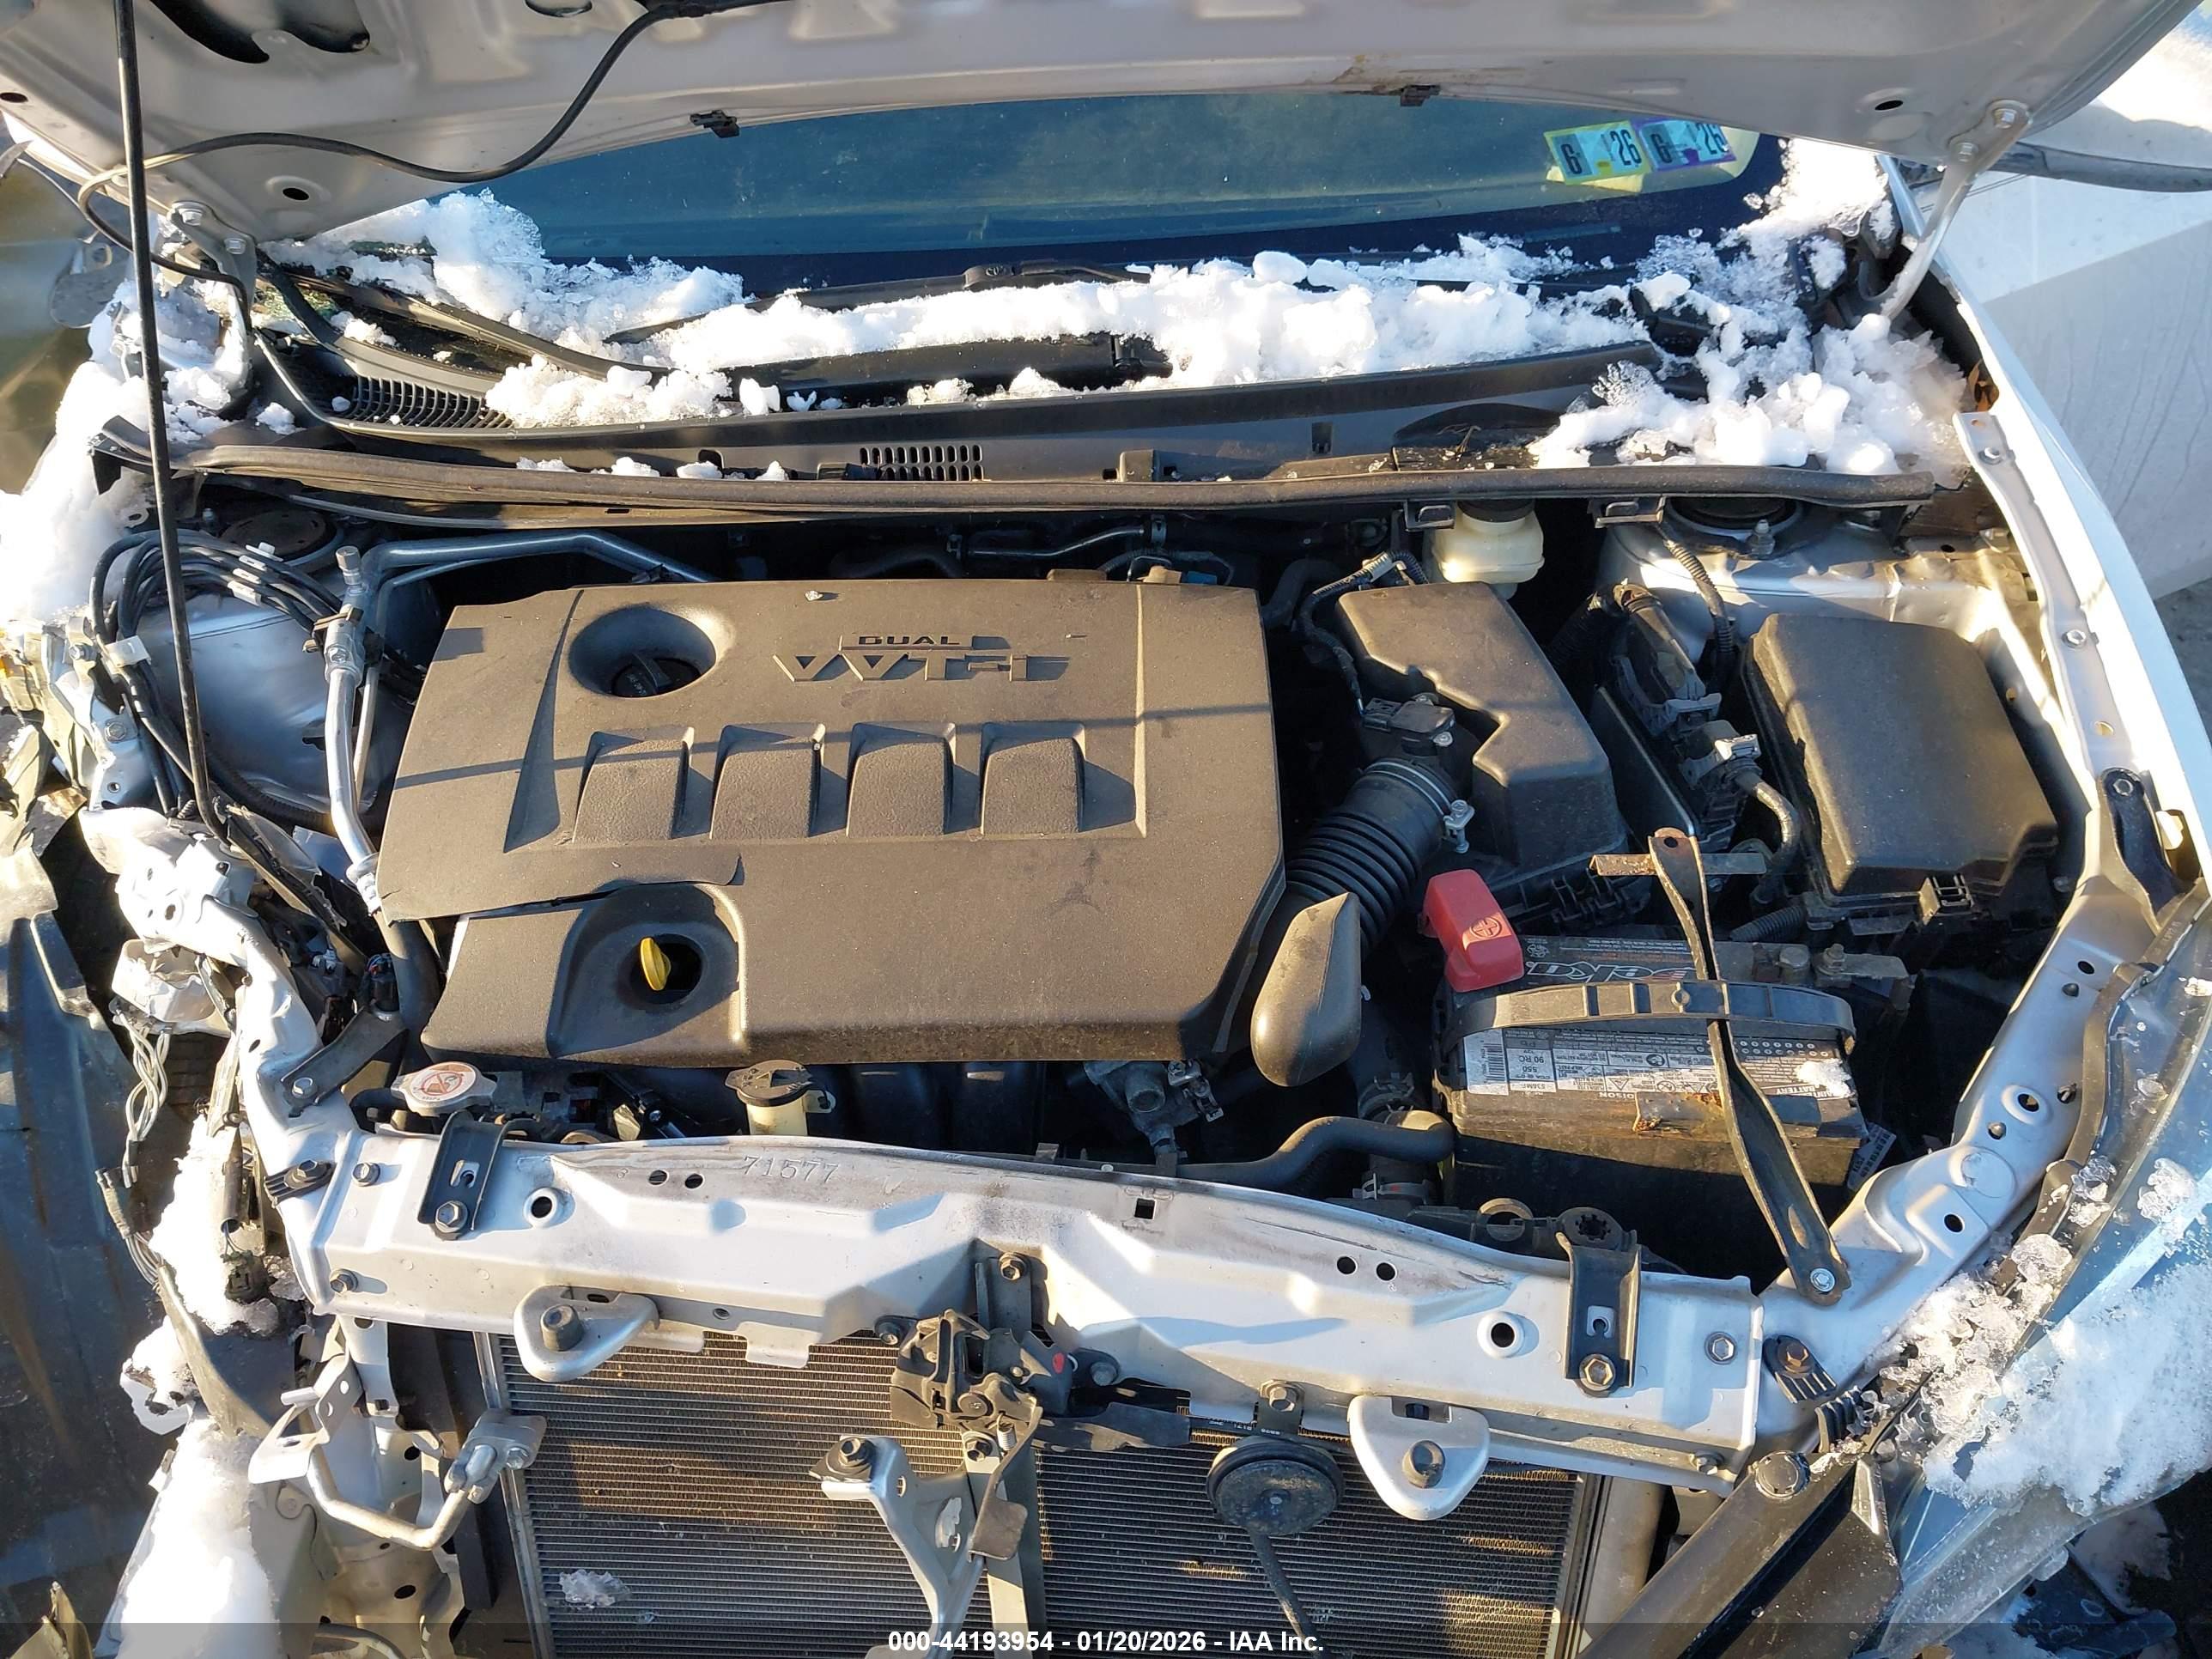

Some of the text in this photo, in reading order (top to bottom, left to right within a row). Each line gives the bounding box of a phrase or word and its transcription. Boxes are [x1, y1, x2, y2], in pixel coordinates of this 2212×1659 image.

[1560, 129, 1643, 175] 6 26
[1650, 122, 1729, 164] 6 26
[858, 635, 960, 646] DUAL
[1775, 1085, 1816, 1095] BATTERY
[743, 1155, 840, 1183] 71577
